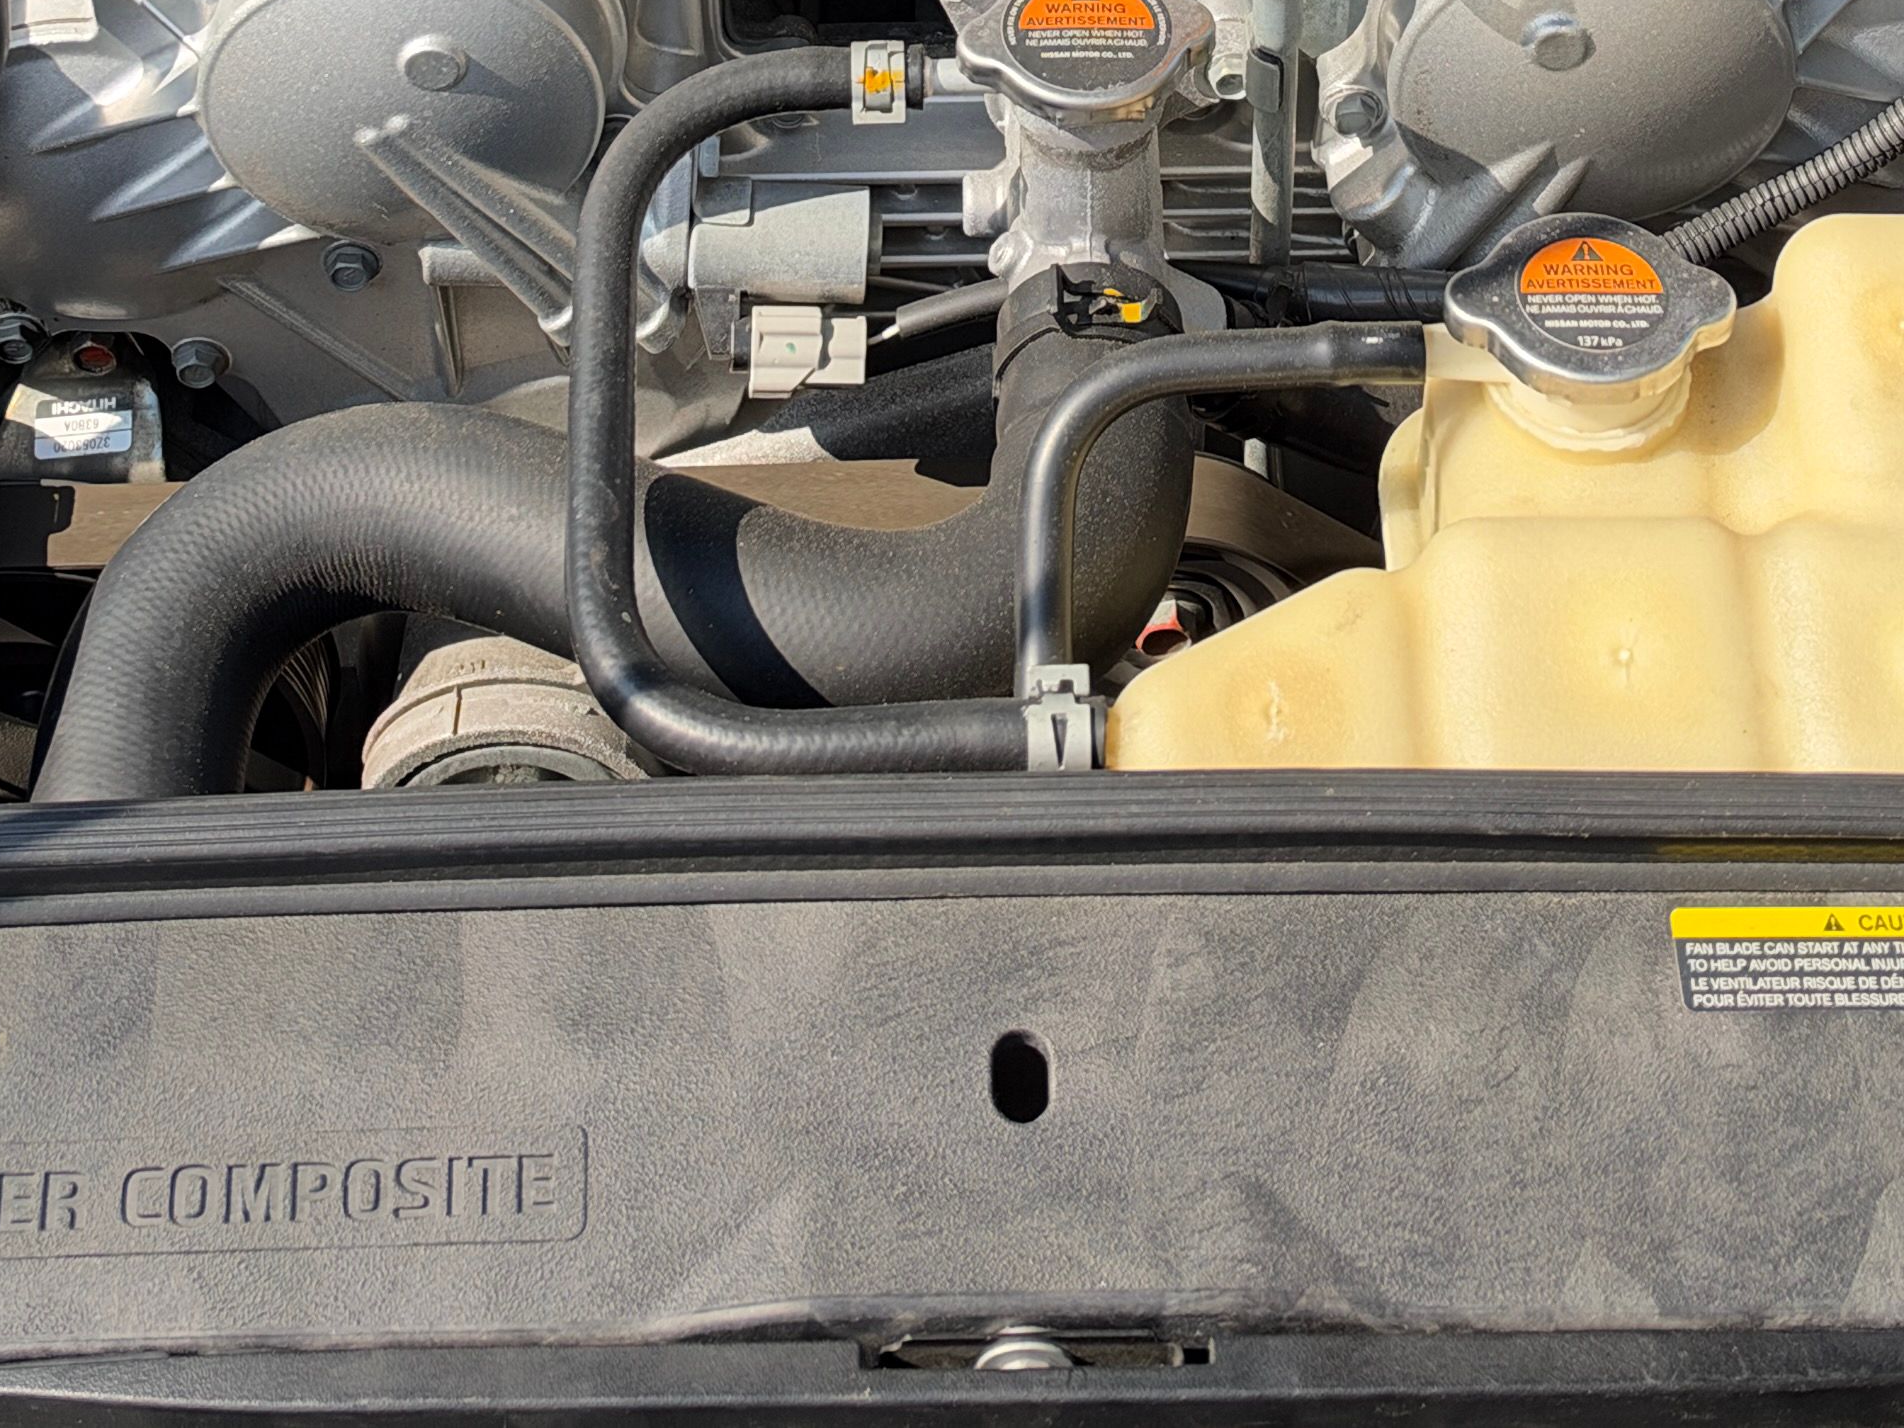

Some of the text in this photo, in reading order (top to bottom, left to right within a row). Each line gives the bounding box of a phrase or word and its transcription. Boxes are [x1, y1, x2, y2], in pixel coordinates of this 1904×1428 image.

[1046, 2, 1126, 14] WARNING
[1026, 16, 1146, 26] AVERTISSEMENT
[1028, 30, 1059, 38] NEVER
[1061, 30, 1089, 38] OPEN
[1090, 30, 1121, 38] WHEN
[1025, 38, 1038, 46] NE
[1039, 38, 1070, 47] JAMAIS
[1040, 51, 1070, 59] NISSAN
[1072, 51, 1100, 59] MOTOR
[1543, 264, 1634, 276] WARNING
[1527, 278, 1656, 290] AVERTISSEMENT
[1527, 294, 1659, 305] NEVER OPEN WHEN HOT.
[1525, 305, 1541, 313] NE
[1542, 305, 1577, 314] JAMAIS
[1578, 305, 1616, 314] OUVRIR
[1579, 320, 1611, 328] MOTOR
[1632, 320, 1649, 328] LTD.
[1577, 336, 1623, 347] 137 kPa
[49, 395, 118, 417] HITACHI
[1685, 941, 1714, 955] FAN
[1716, 941, 1762, 955] BLADE
[1764, 941, 1796, 955] CAN
[1797, 941, 1839, 955] START
[1840, 941, 1859, 955] AT
[1861, 941, 1891, 955] ANY
[1687, 958, 1708, 972] TO
[1710, 958, 1747, 972] HELP
[1748, 958, 1792, 972] AVOID
[1793, 957, 1870, 972] PERSONAL
[1690, 975, 1708, 991] LE
[1710, 975, 1802, 991] VENTILATEUR
[1803, 975, 1857, 991] RISQUE
[1858, 975, 1880, 990] DE
[1692, 992, 1735, 1008] POUR
[1736, 989, 1785, 1008] ÉVITER
[1786, 992, 1833, 1008] TOUTE
[119, 1151, 561, 1229] COMPOSITE
